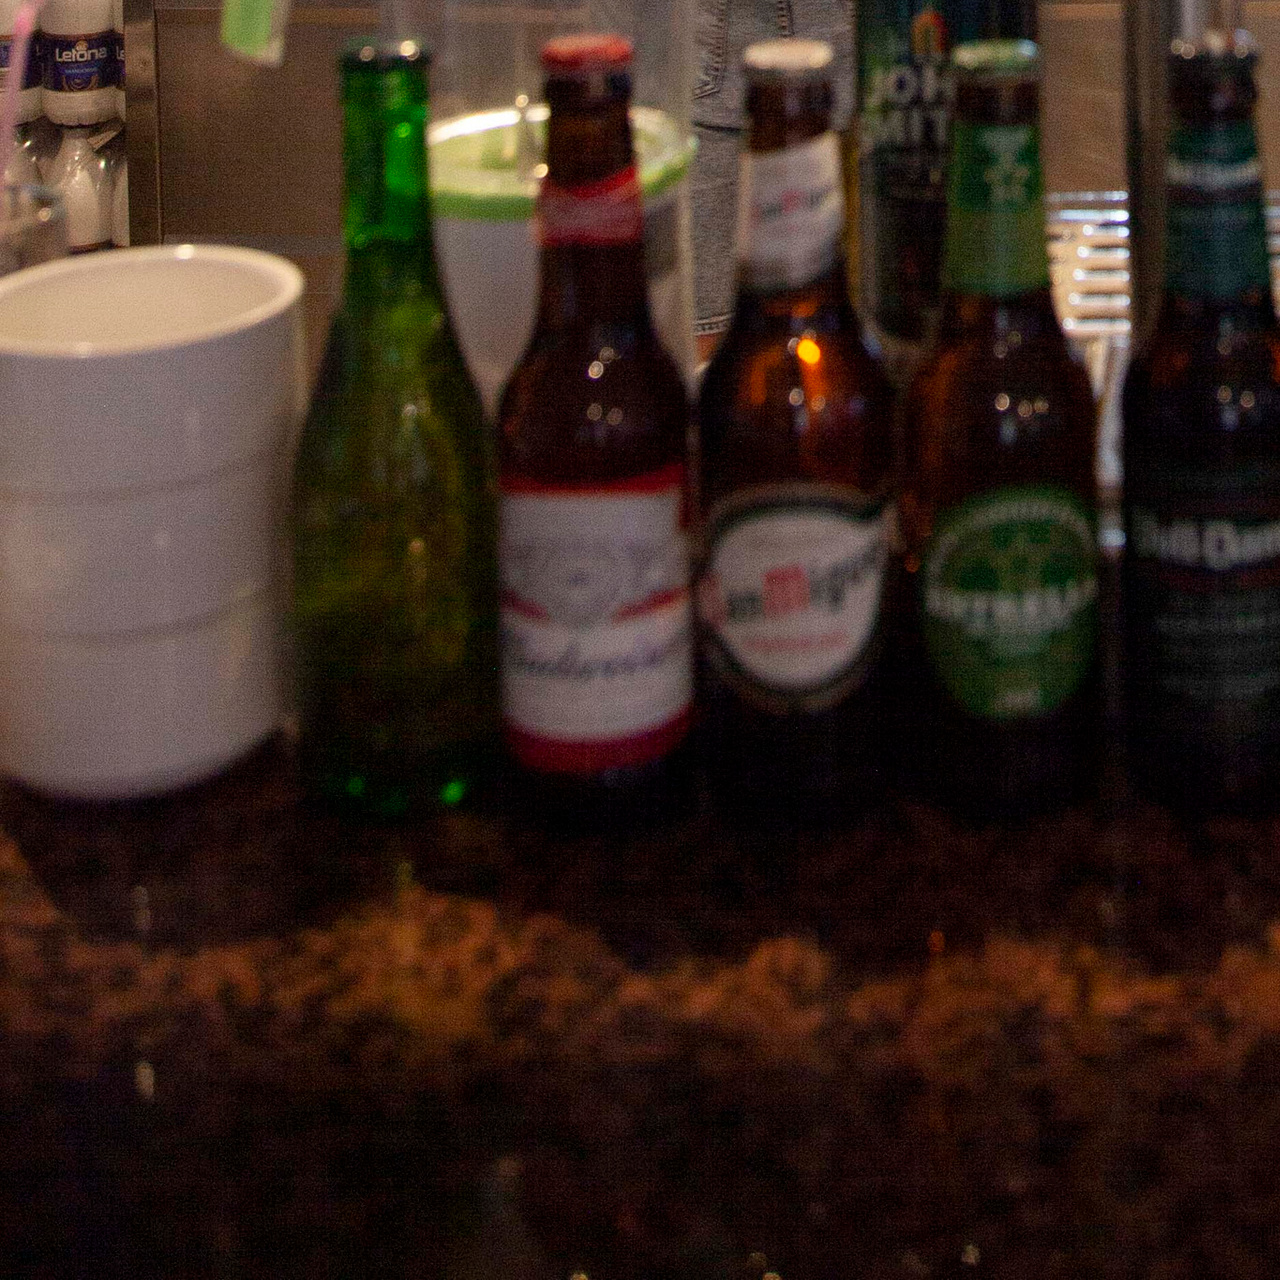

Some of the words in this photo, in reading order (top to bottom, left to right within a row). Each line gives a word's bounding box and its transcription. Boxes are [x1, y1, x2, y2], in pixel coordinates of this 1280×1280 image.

[56, 45, 108, 62] Letona
[866, 64, 955, 107] JOH
[860, 108, 950, 147] MIT
